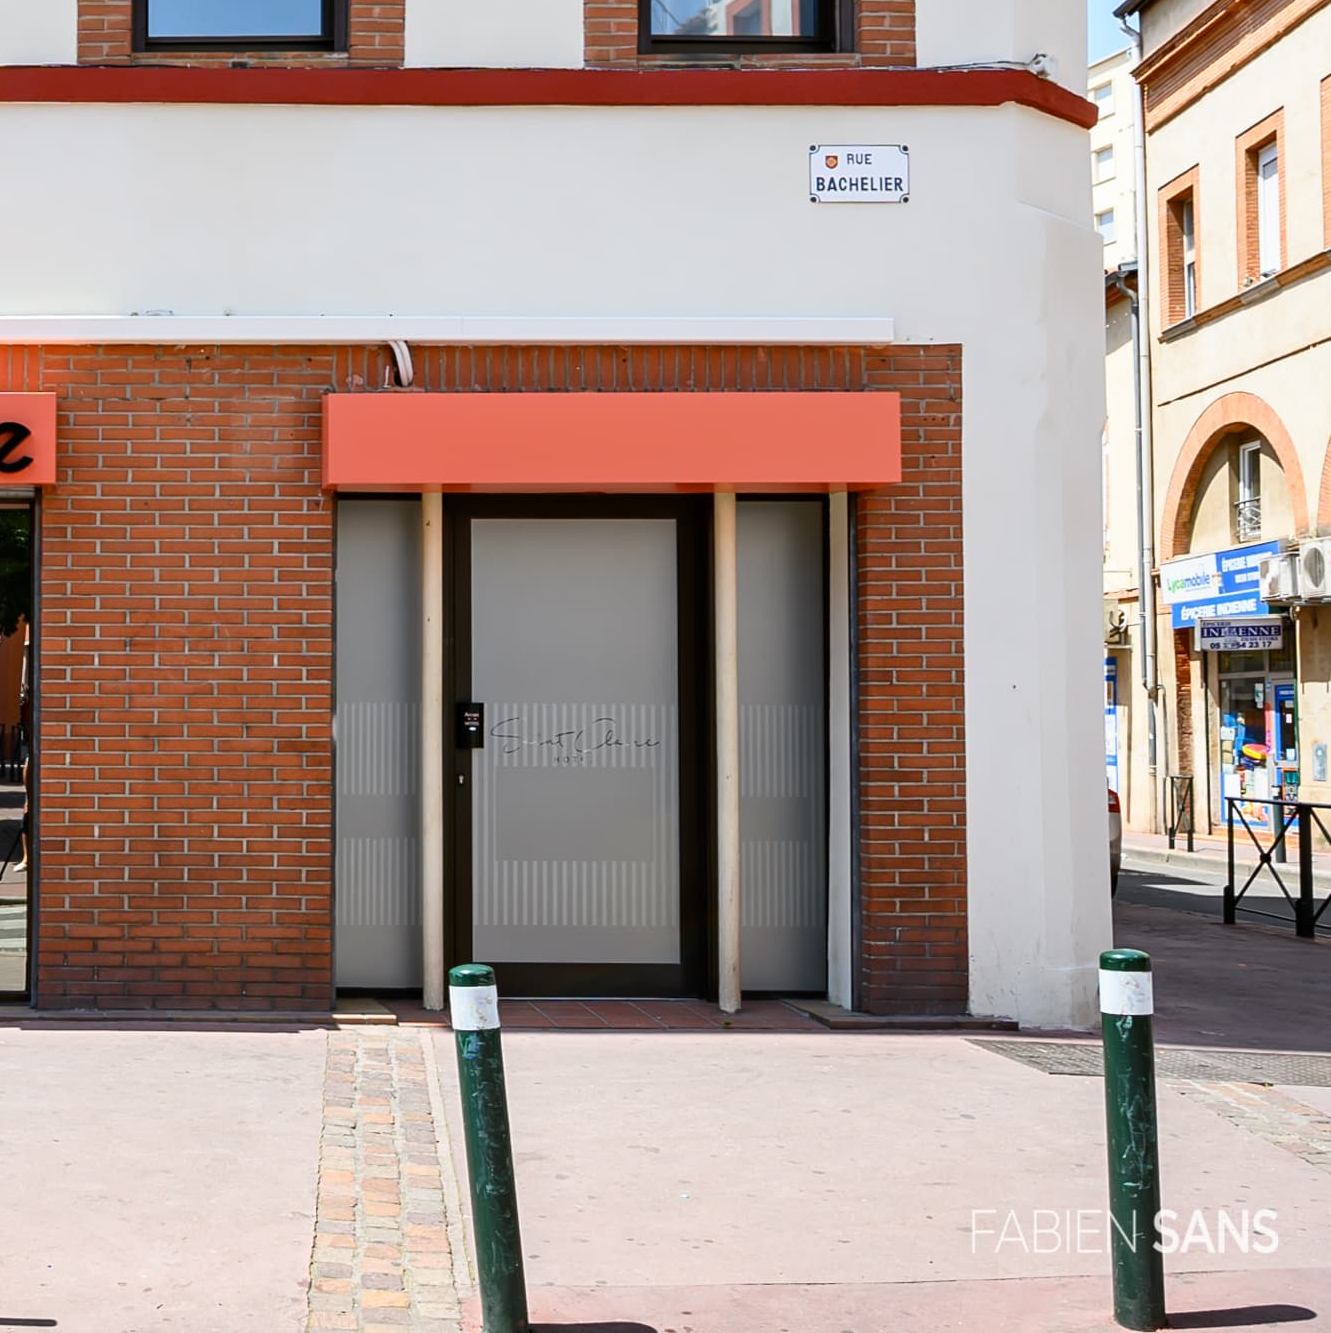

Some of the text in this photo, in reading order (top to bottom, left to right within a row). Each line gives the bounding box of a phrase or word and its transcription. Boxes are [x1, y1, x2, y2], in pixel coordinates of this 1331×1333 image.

[846, 153, 873, 165] RUE
[816, 176, 904, 192] BACHELIER
[1165, 571, 1211, 594] Lycamobile
[1203, 626, 1279, 637] INENNE
[553, 755, 593, 764] HOT
